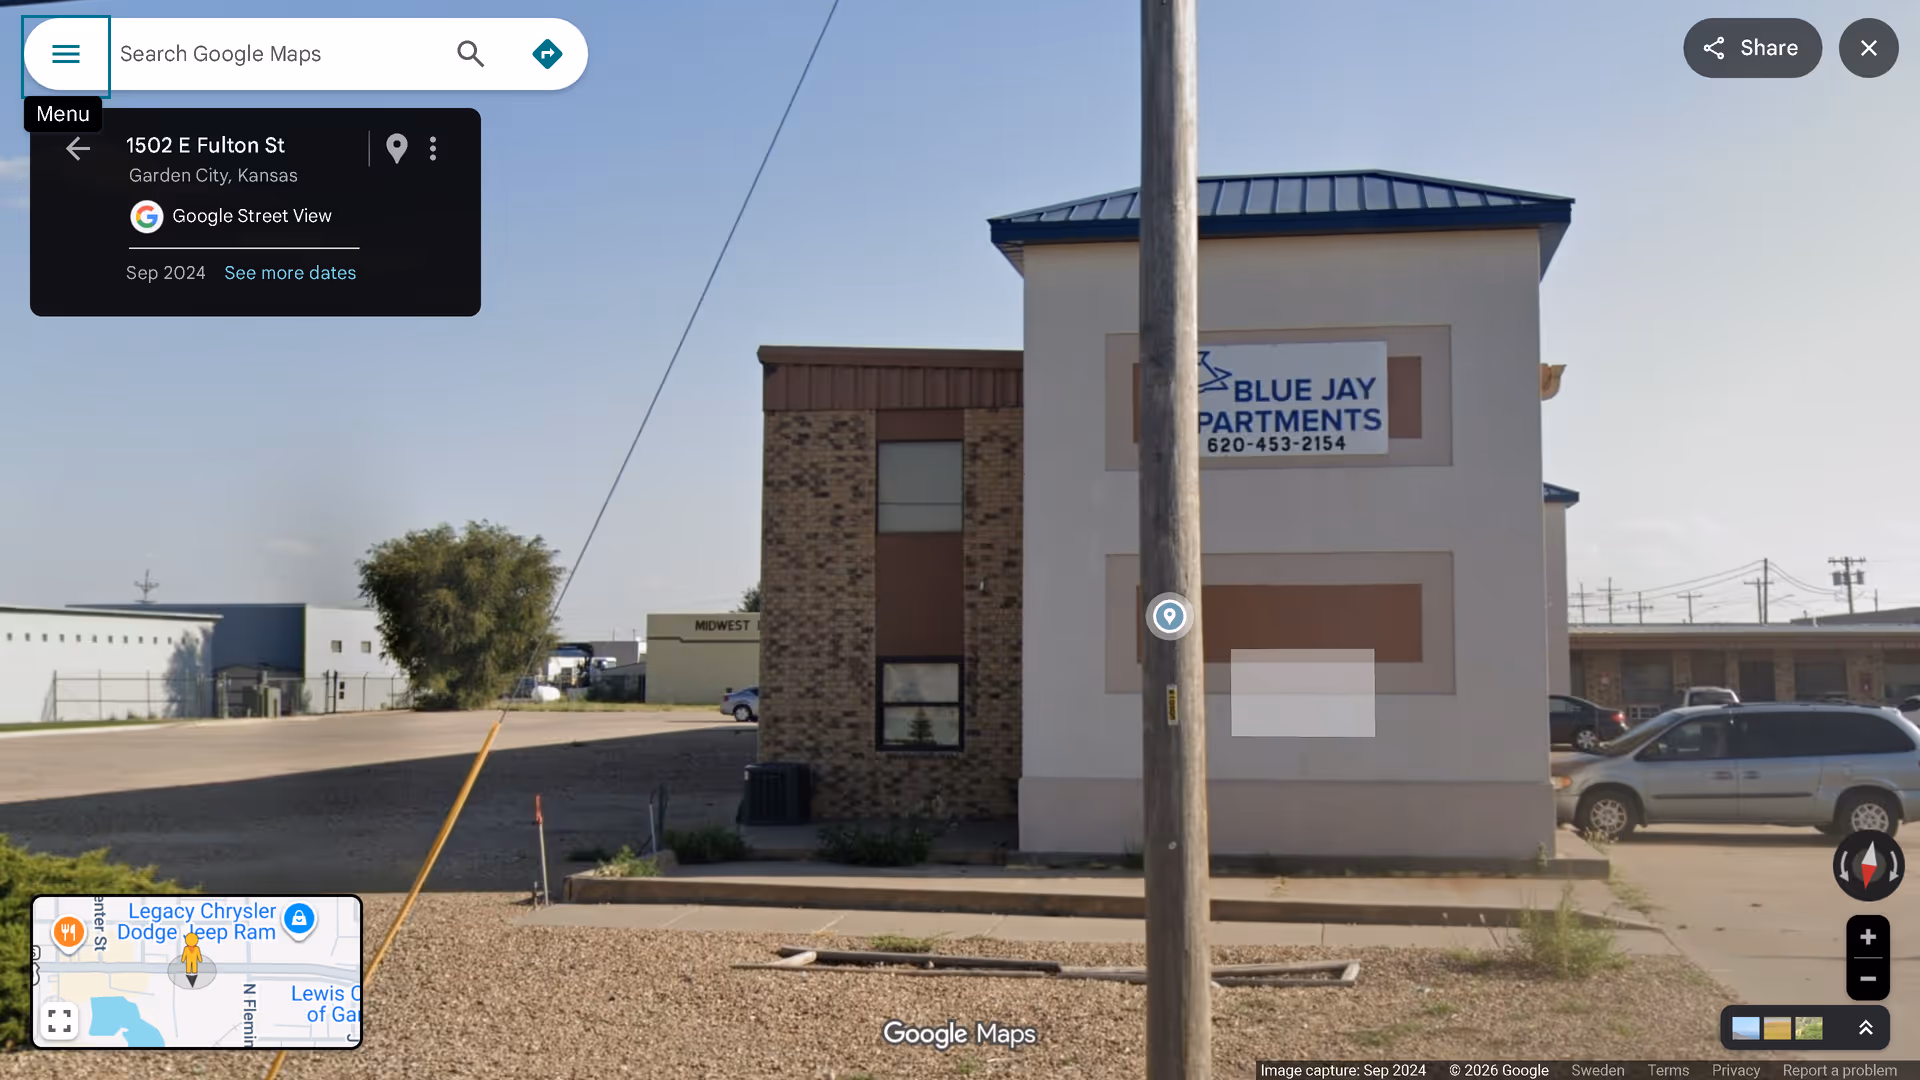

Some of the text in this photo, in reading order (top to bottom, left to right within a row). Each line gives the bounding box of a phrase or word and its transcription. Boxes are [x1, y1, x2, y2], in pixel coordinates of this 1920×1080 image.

[1234, 377, 1377, 403] BLUE JAY
[1207, 435, 1347, 453] 620-453-2154
[695, 620, 750, 631] MIDWEST
